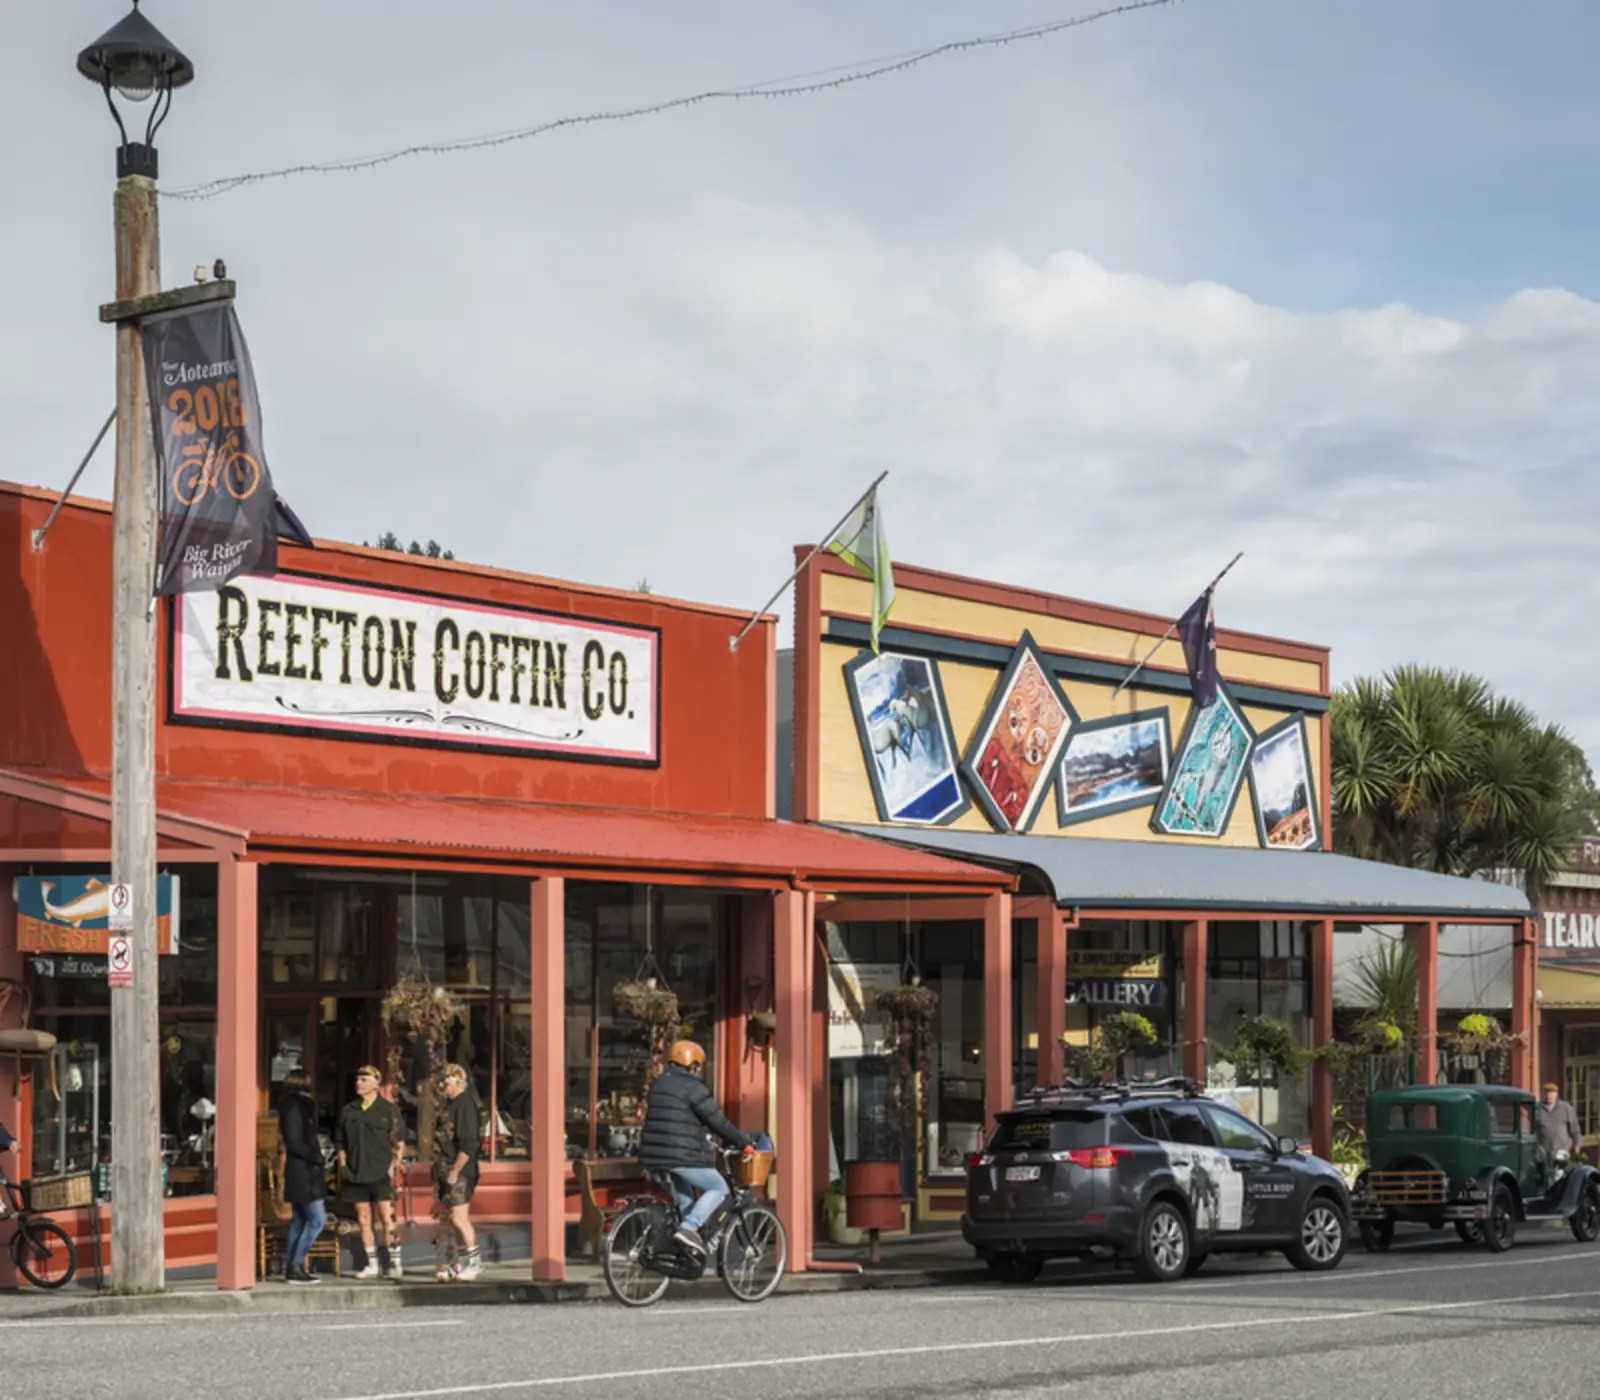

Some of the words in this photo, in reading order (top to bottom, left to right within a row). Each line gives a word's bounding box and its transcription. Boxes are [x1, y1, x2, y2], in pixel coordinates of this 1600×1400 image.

[168, 377, 247, 437] 2018
[183, 545, 209, 565] Big
[214, 584, 418, 693] REEFTON
[432, 617, 568, 710] COFFIN
[581, 639, 636, 722] CO.
[23, 918, 100, 950] FRESH
